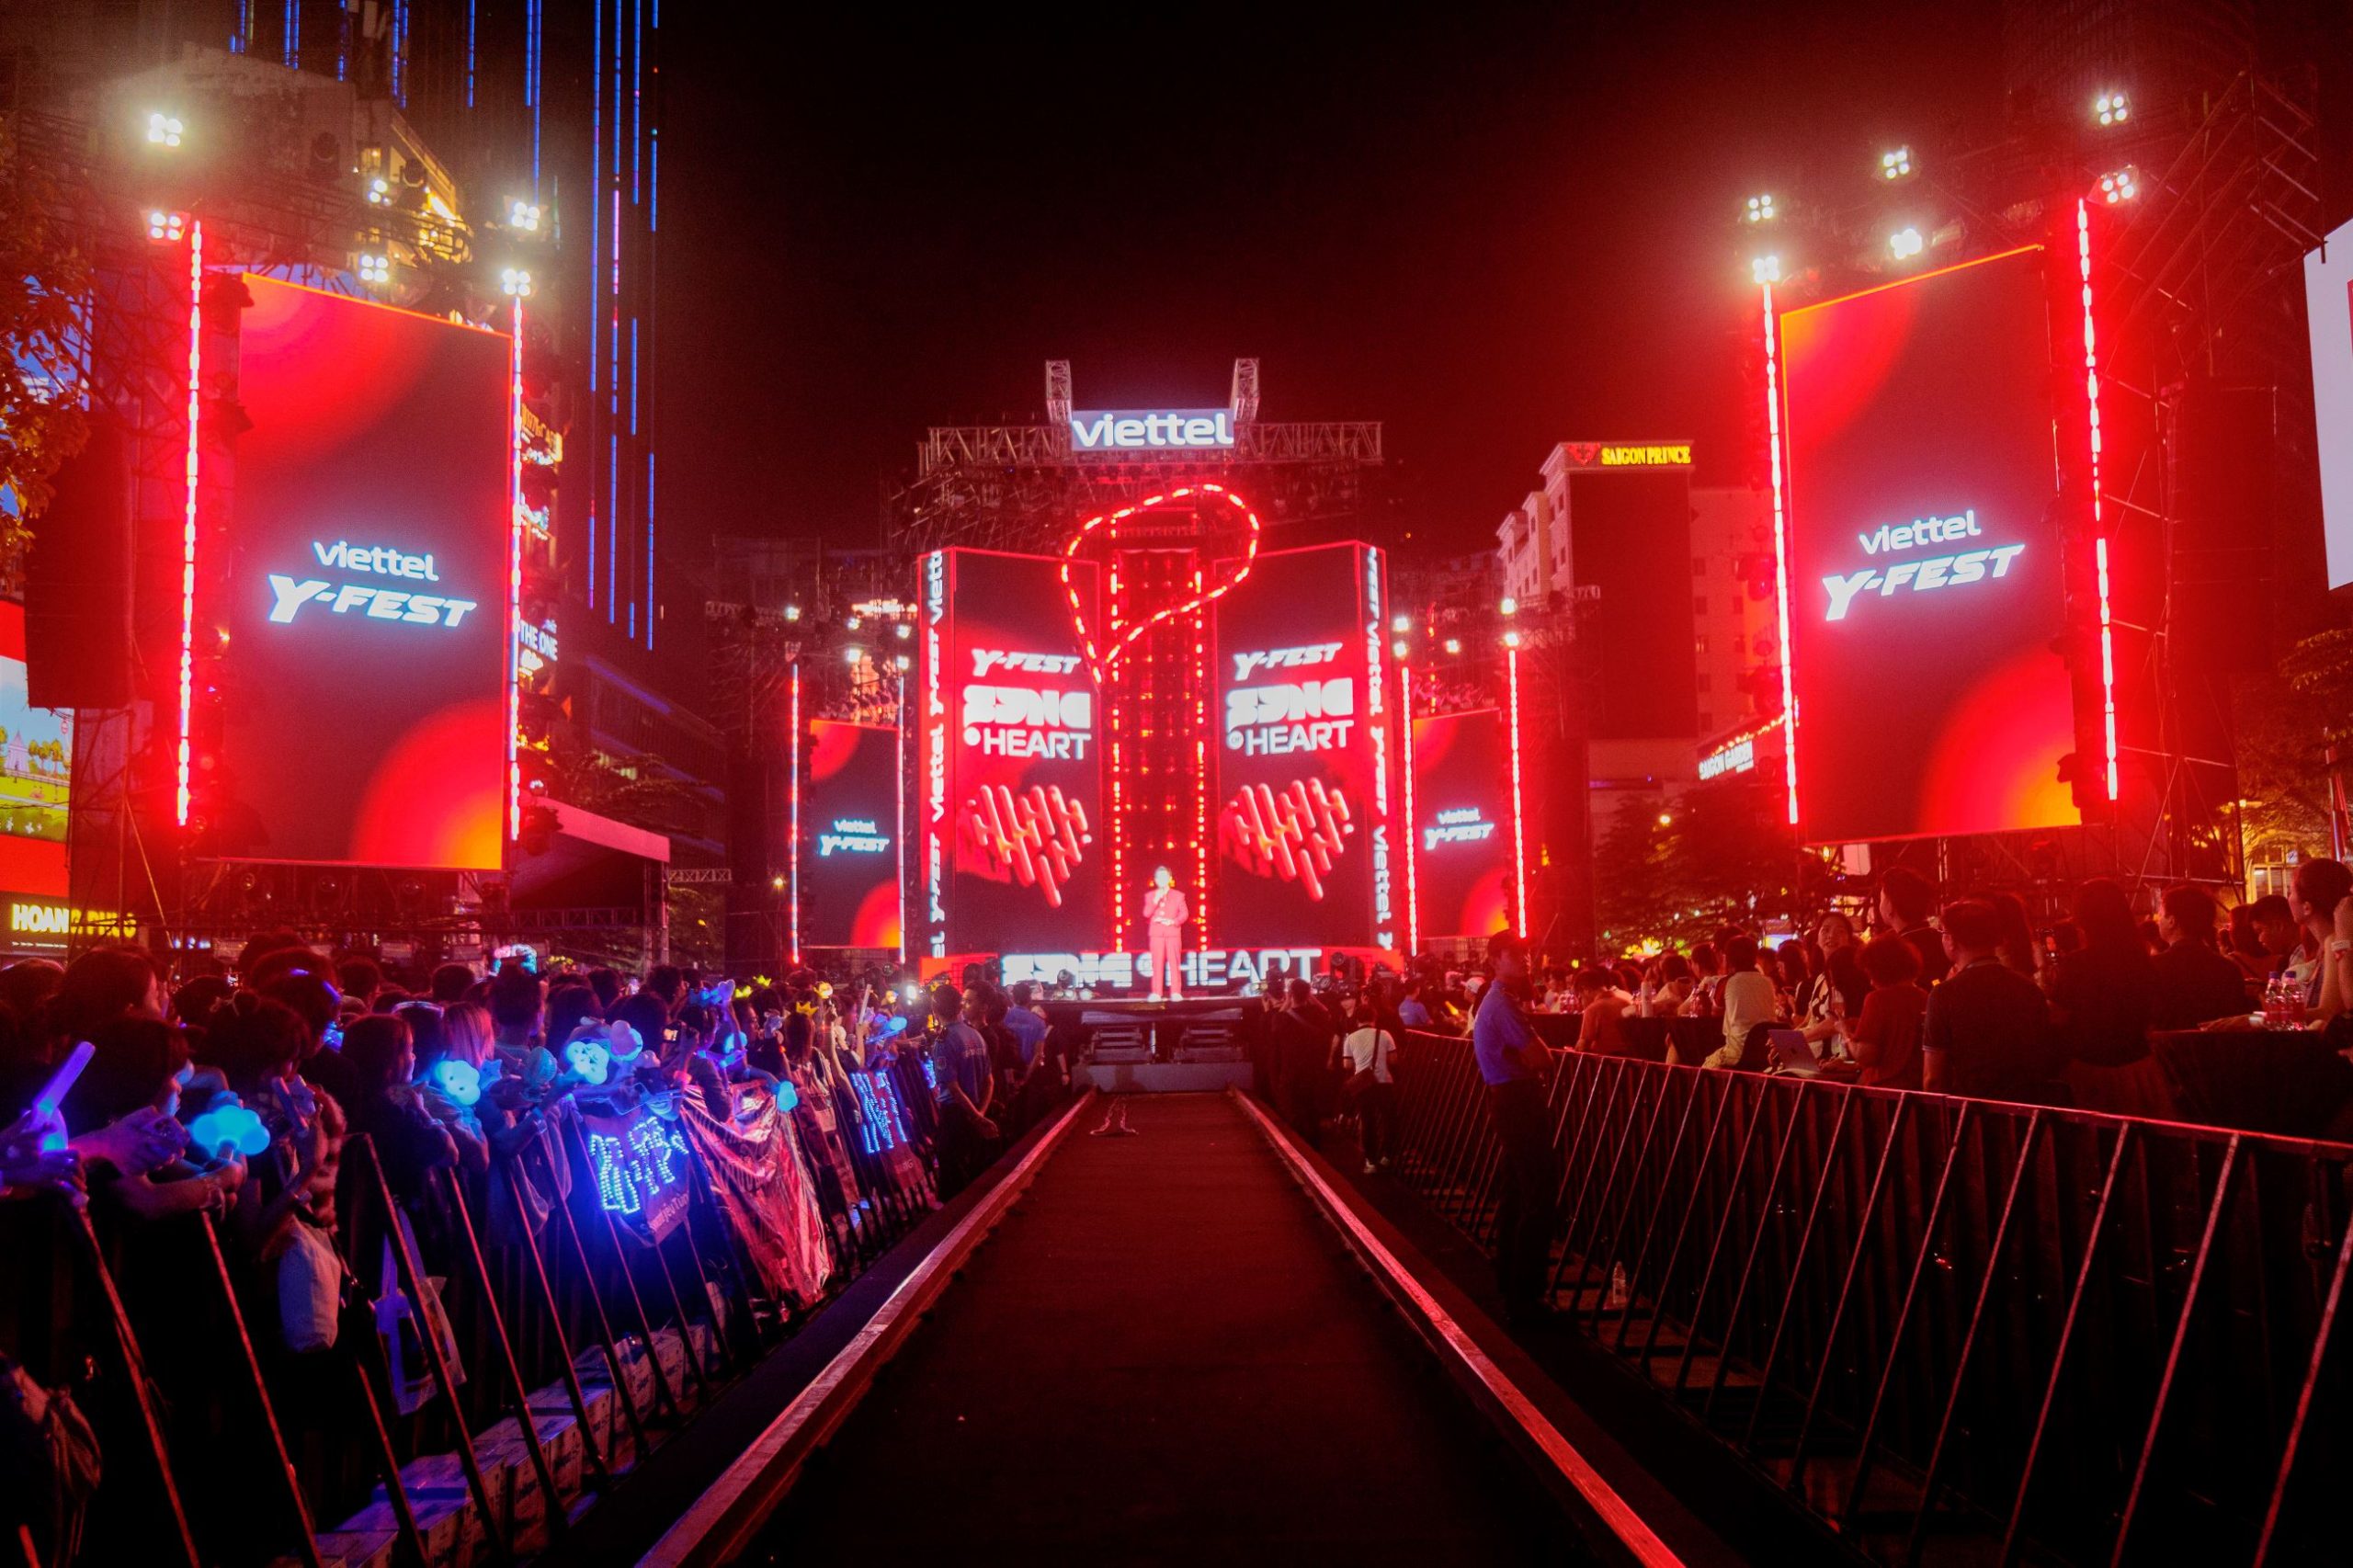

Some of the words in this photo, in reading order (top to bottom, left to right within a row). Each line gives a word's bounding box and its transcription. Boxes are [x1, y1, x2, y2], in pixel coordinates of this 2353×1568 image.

[1072, 413, 1234, 448] viettel
[1601, 447, 1646, 465] SAIGON
[1647, 446, 1691, 464] PRINCE
[1859, 509, 1982, 555] viettel
[313, 540, 439, 582] viettel
[267, 574, 478, 628] Y-FEST
[1821, 543, 2026, 622] Y-FEST
[972, 648, 1082, 677] Y-FEST
[1233, 642, 1344, 682] Y-FEST
[983, 727, 1092, 760] HEART
[1245, 719, 1355, 756] HEART
